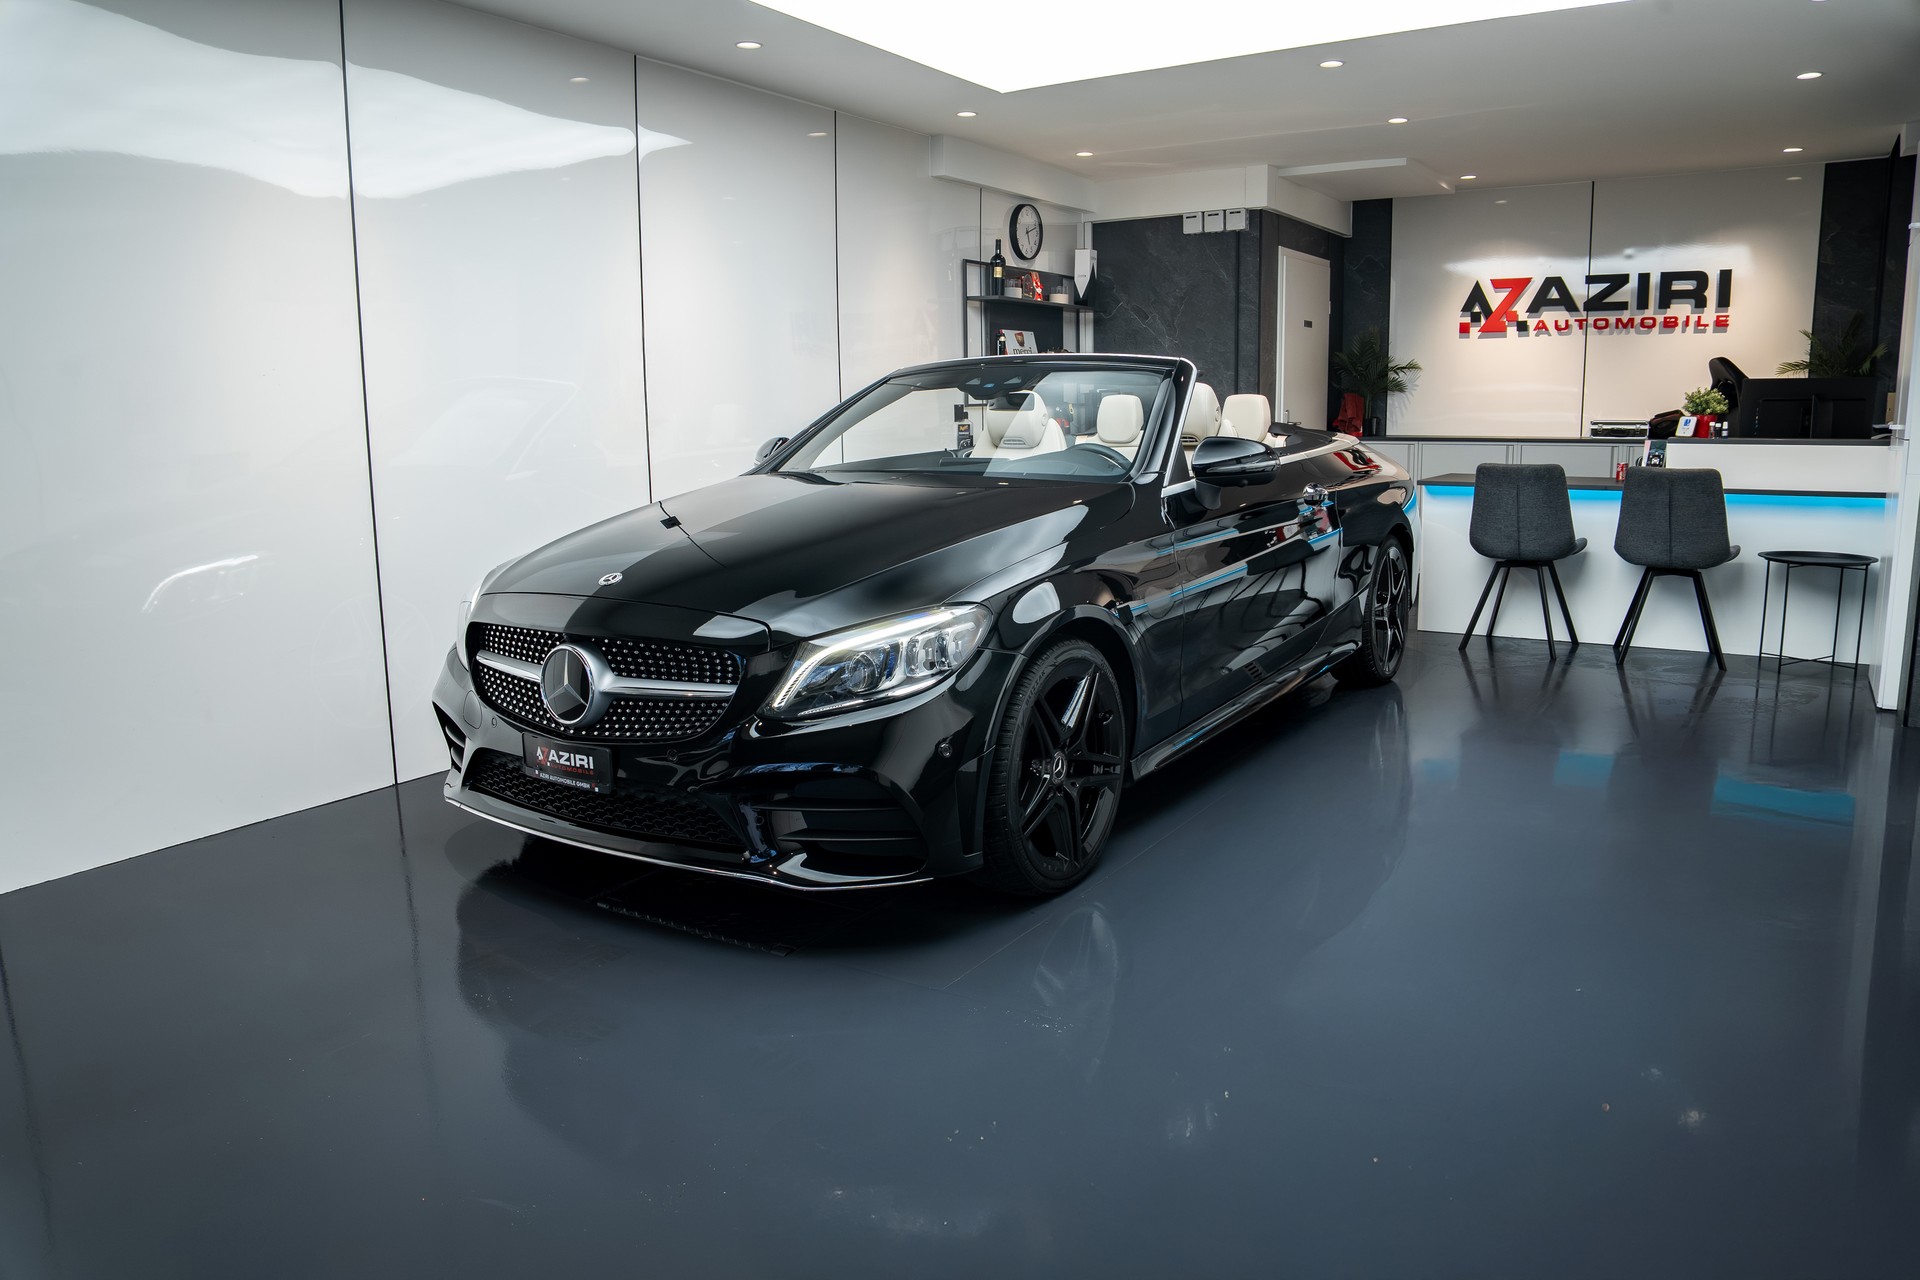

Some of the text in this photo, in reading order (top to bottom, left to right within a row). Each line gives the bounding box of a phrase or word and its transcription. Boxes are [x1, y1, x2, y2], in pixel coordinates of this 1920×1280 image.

[1526, 269, 1733, 313] AZIRI
[1533, 314, 1731, 332] AUTOMOBILE
[548, 749, 594, 770] AZIRI
[550, 763, 594, 776] AUTOMOBILE
